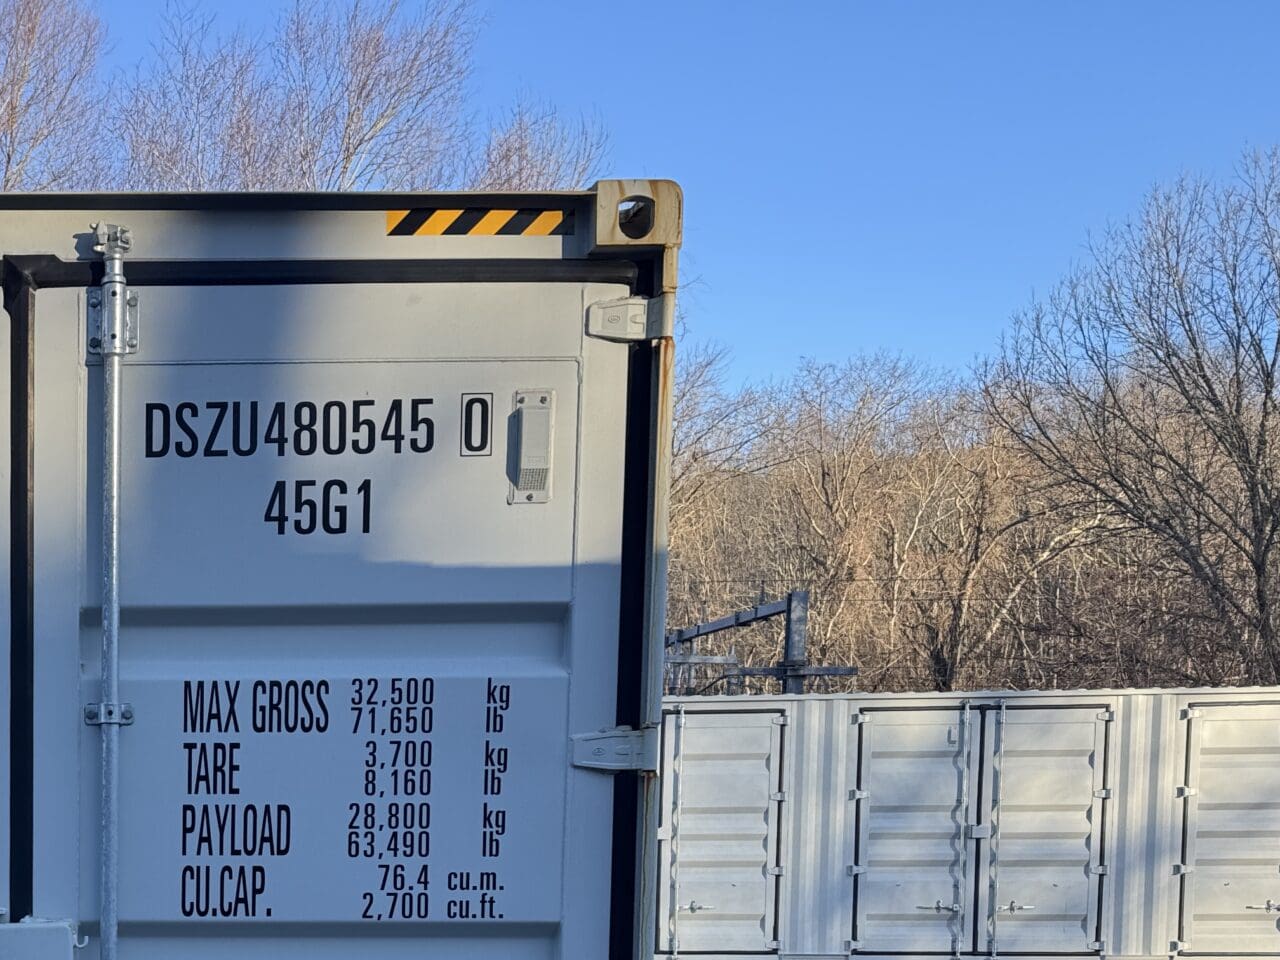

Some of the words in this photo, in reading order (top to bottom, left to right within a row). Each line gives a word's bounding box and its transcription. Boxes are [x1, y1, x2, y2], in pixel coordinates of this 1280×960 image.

[145, 399, 434, 458] DSZU480545
[464, 398, 489, 452] 0
[264, 479, 371, 535] 45G1
[183, 680, 240, 733] MAX
[252, 680, 330, 733] GROSS
[351, 678, 434, 707] 32,500
[487, 677, 511, 710] kg
[350, 706, 433, 736] 71,650
[486, 706, 504, 733] lb
[183, 742, 240, 795] TARE
[365, 740, 432, 769] 3,700
[484, 740, 508, 773] kg
[364, 769, 432, 798] 8,160
[483, 768, 501, 795] lb
[182, 804, 291, 856] PAYLOAD
[348, 802, 431, 832] 28,800
[482, 802, 506, 835] kg
[347, 831, 430, 860] 63,490
[482, 831, 500, 858] lb
[181, 865, 272, 917] CU.CAP.
[377, 864, 430, 891] 76.4
[447, 870, 505, 891] cu.m.
[362, 892, 429, 921] 2,700
[447, 893, 504, 920] cu.ft.
